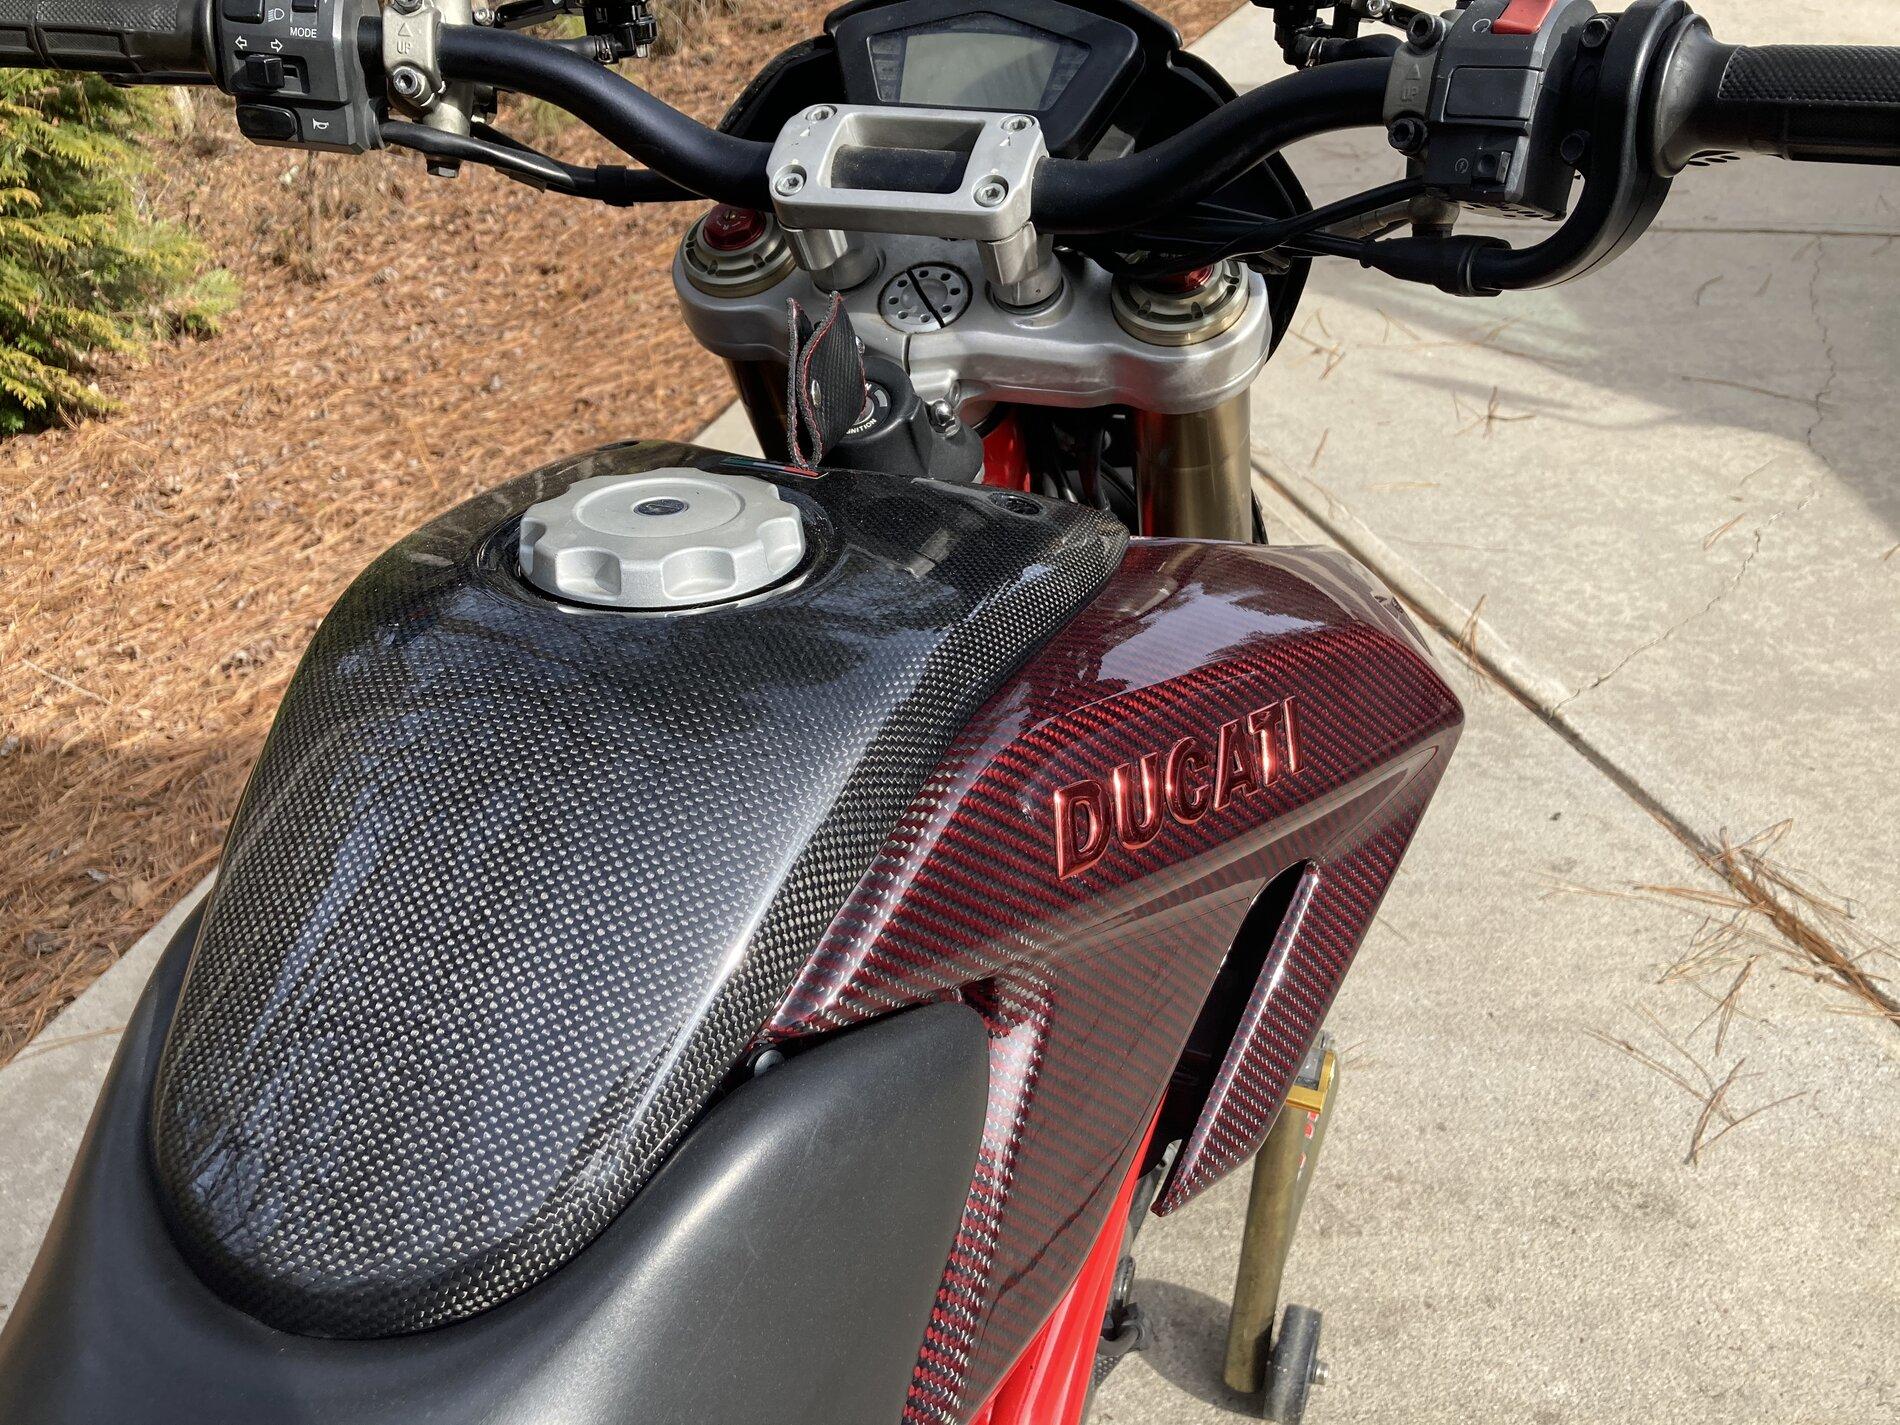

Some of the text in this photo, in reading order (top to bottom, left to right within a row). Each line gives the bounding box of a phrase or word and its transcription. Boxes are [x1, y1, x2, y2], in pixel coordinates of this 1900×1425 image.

[289, 26, 317, 38] MODE
[396, 41, 411, 55] UP
[1054, 695, 1305, 882] DUCATI
